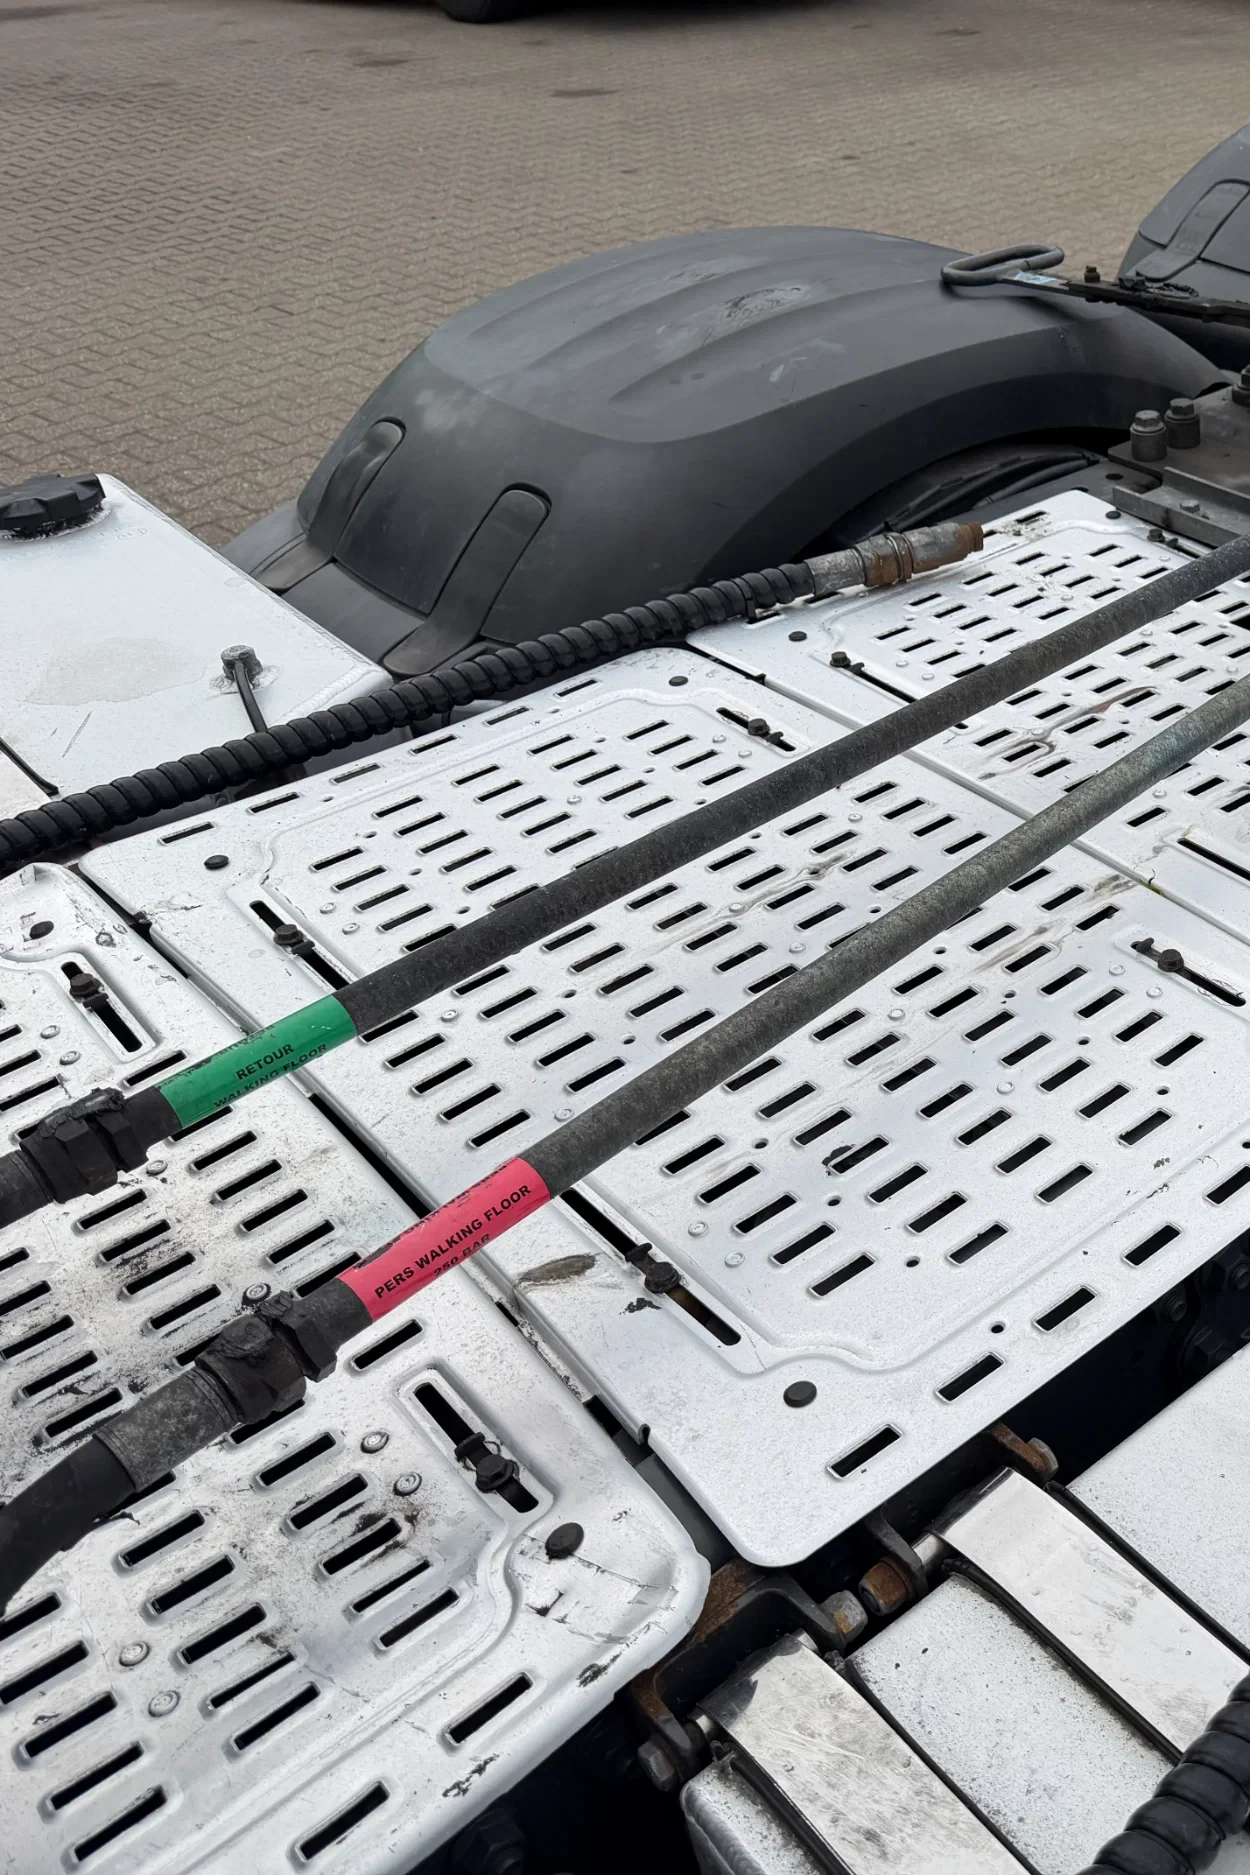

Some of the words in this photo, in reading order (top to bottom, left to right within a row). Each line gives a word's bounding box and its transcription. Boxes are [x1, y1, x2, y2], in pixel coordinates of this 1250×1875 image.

[213, 1069, 279, 1107] WALKING
[283, 1043, 328, 1072] FLOOR
[235, 1043, 295, 1080] RETOUR
[374, 1267, 415, 1299] PERS
[415, 1218, 483, 1269] WALKING
[484, 1184, 532, 1222] FLOOR
[433, 1256, 459, 1277] 250
[462, 1233, 491, 1256] BAR
